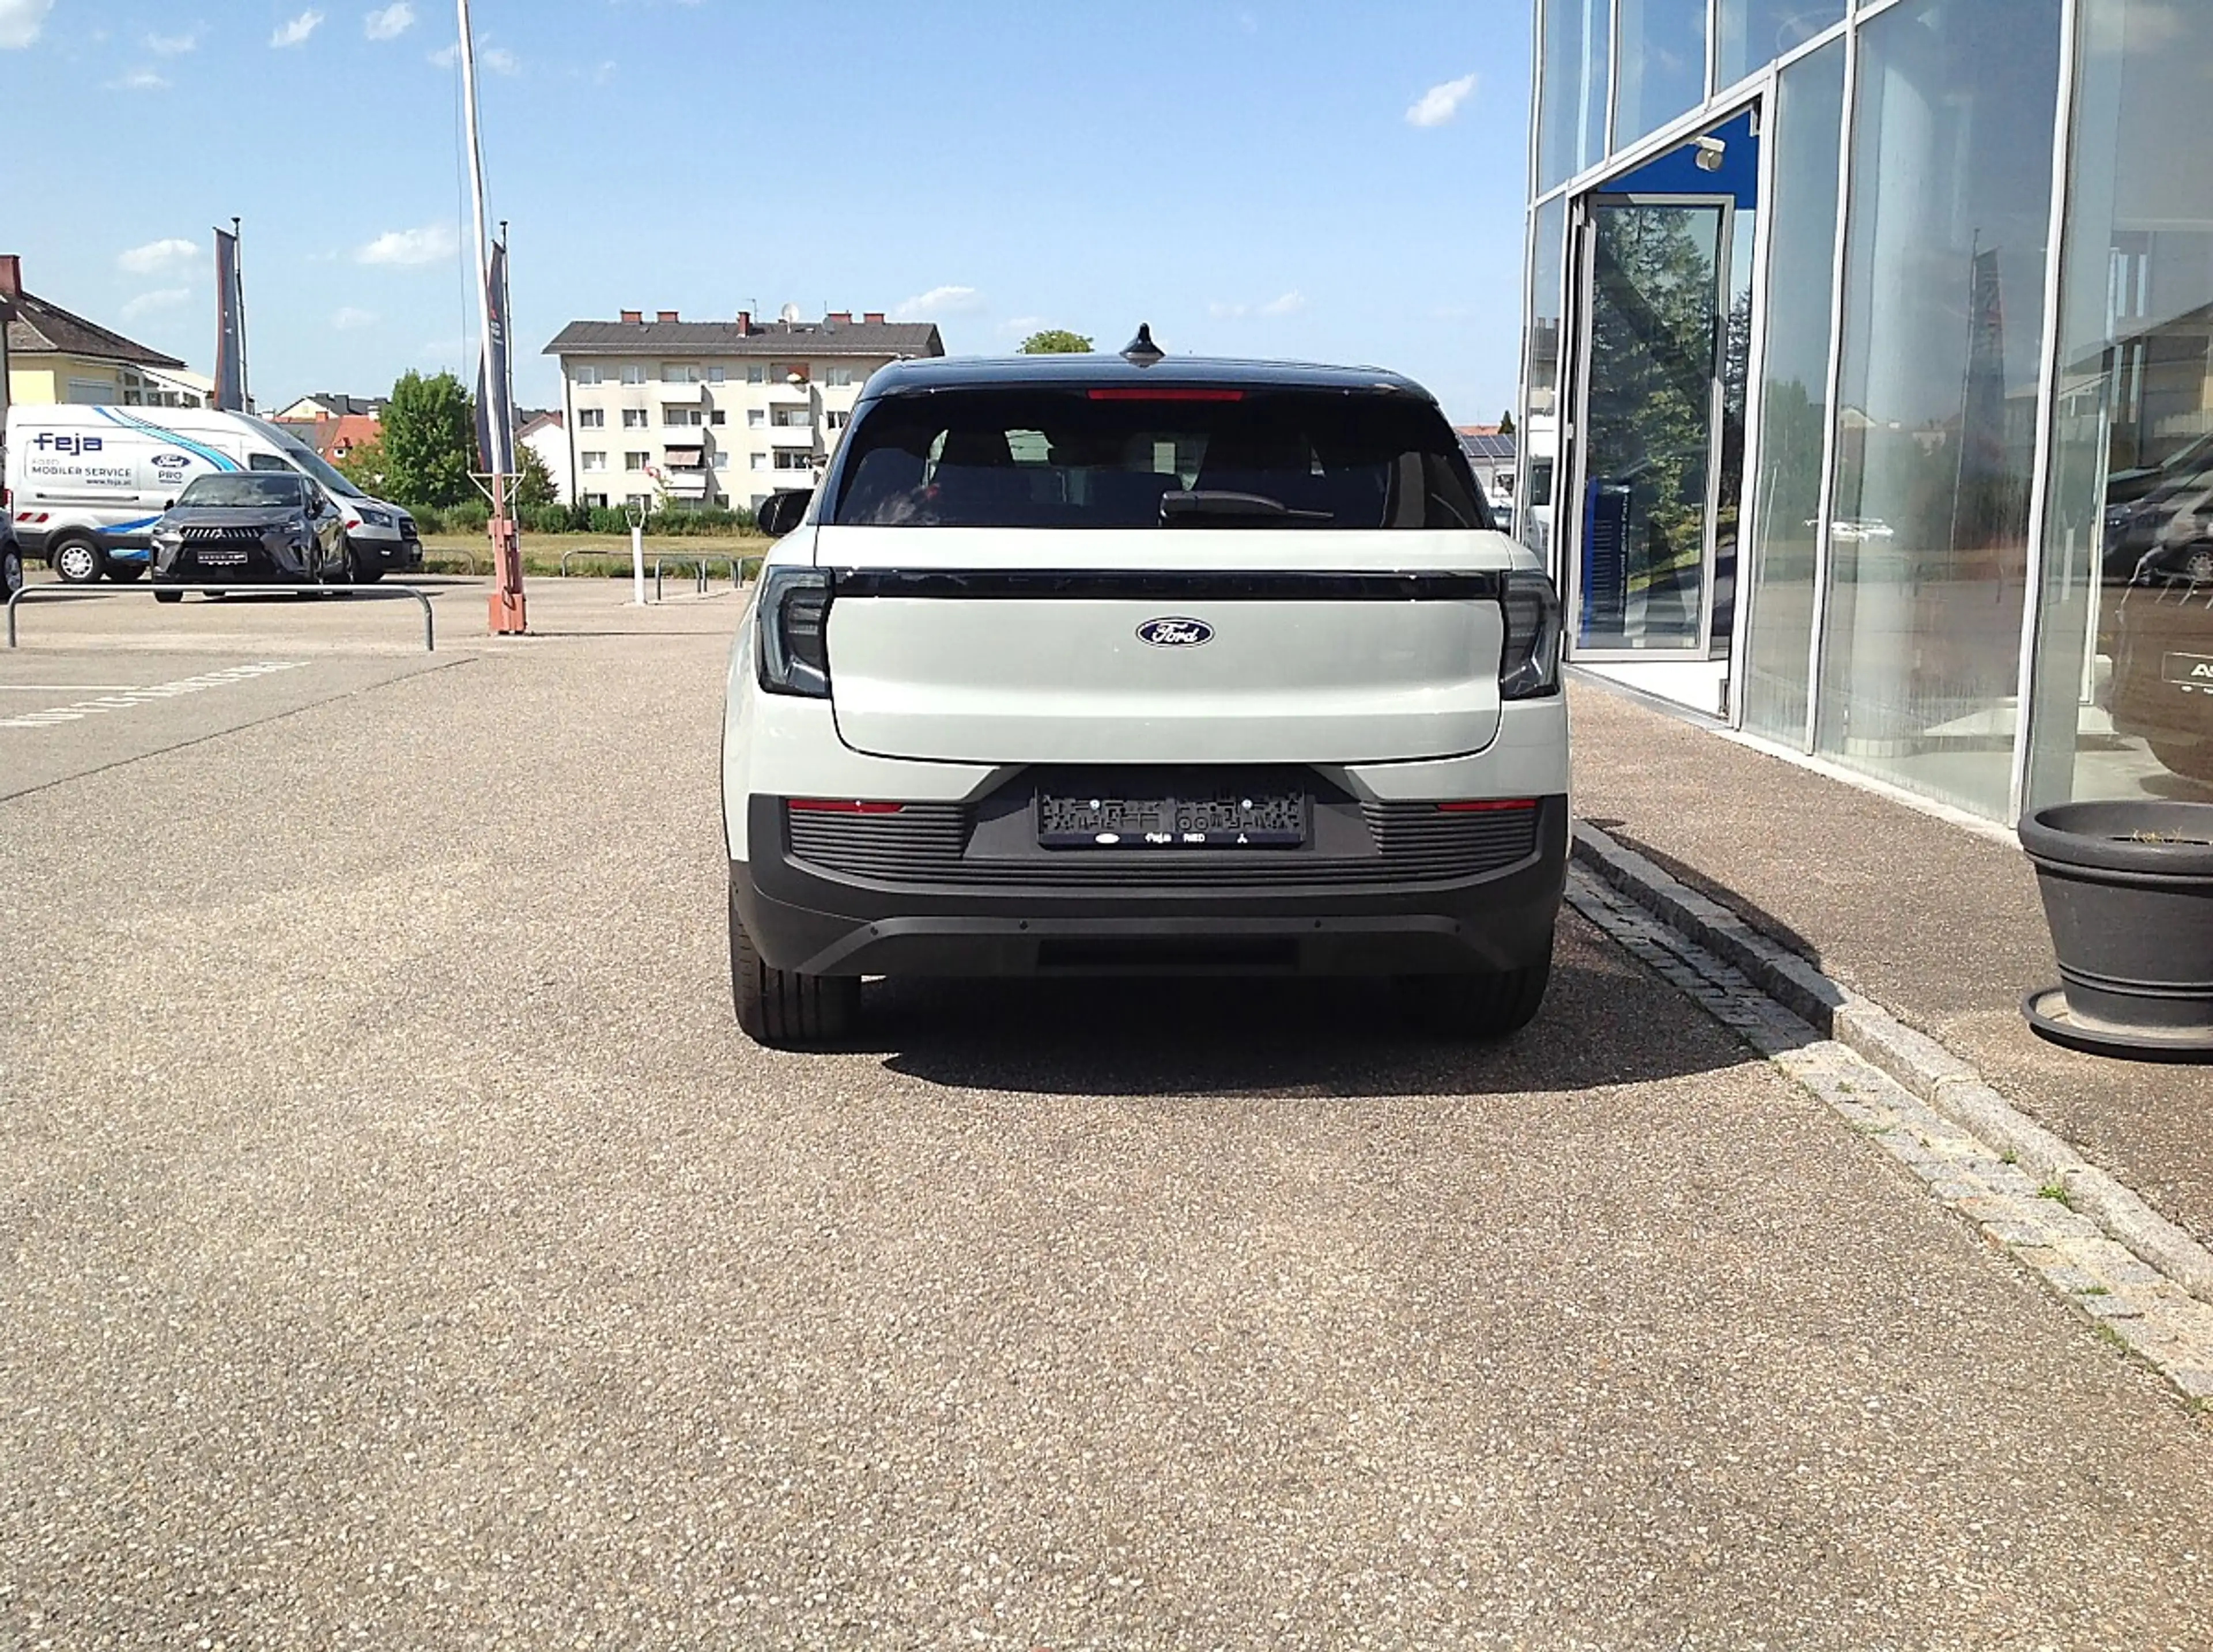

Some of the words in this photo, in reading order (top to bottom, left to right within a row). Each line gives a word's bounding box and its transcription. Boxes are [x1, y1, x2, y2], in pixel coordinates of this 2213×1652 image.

[33, 433, 103, 456] feja
[32, 467, 82, 475] MOBILER
[85, 468, 131, 477] SERVICE
[158, 470, 183, 480] PRO
[1151, 622, 1200, 642] Ford
